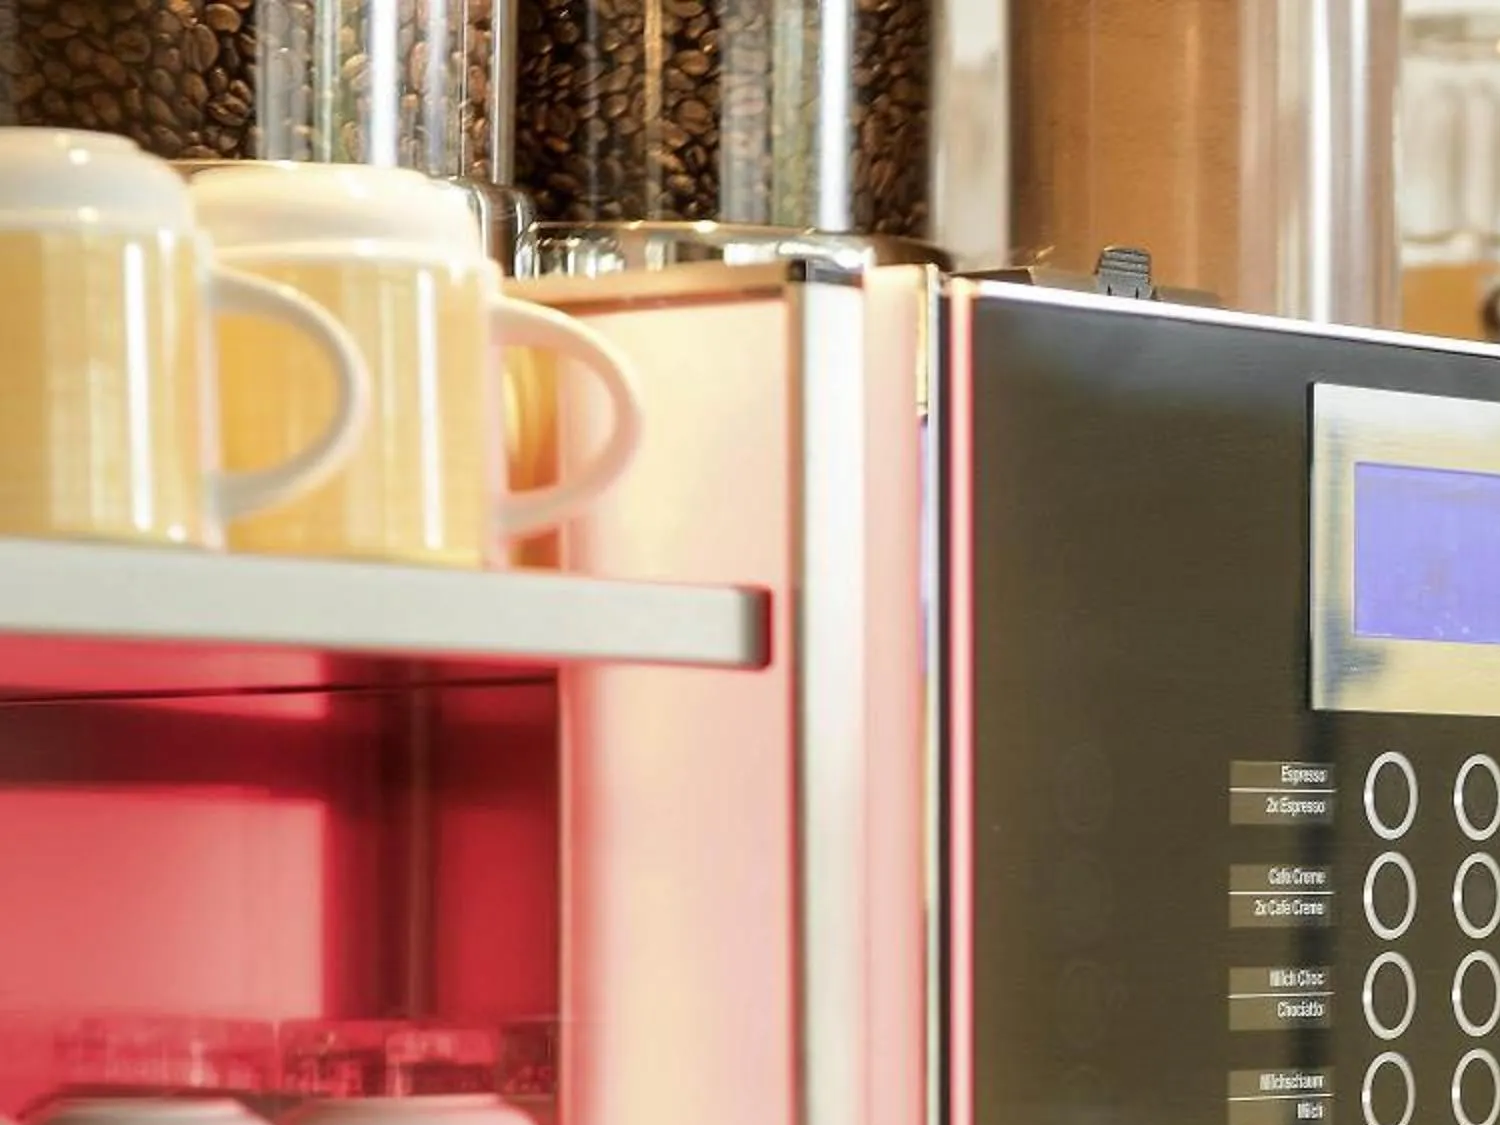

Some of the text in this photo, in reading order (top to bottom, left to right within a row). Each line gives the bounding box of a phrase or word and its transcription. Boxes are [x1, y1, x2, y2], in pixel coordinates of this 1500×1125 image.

[1281, 765, 1328, 785] Espresso
[1265, 797, 1326, 817] 2x Espresso
[1254, 899, 1267, 916] 2x
